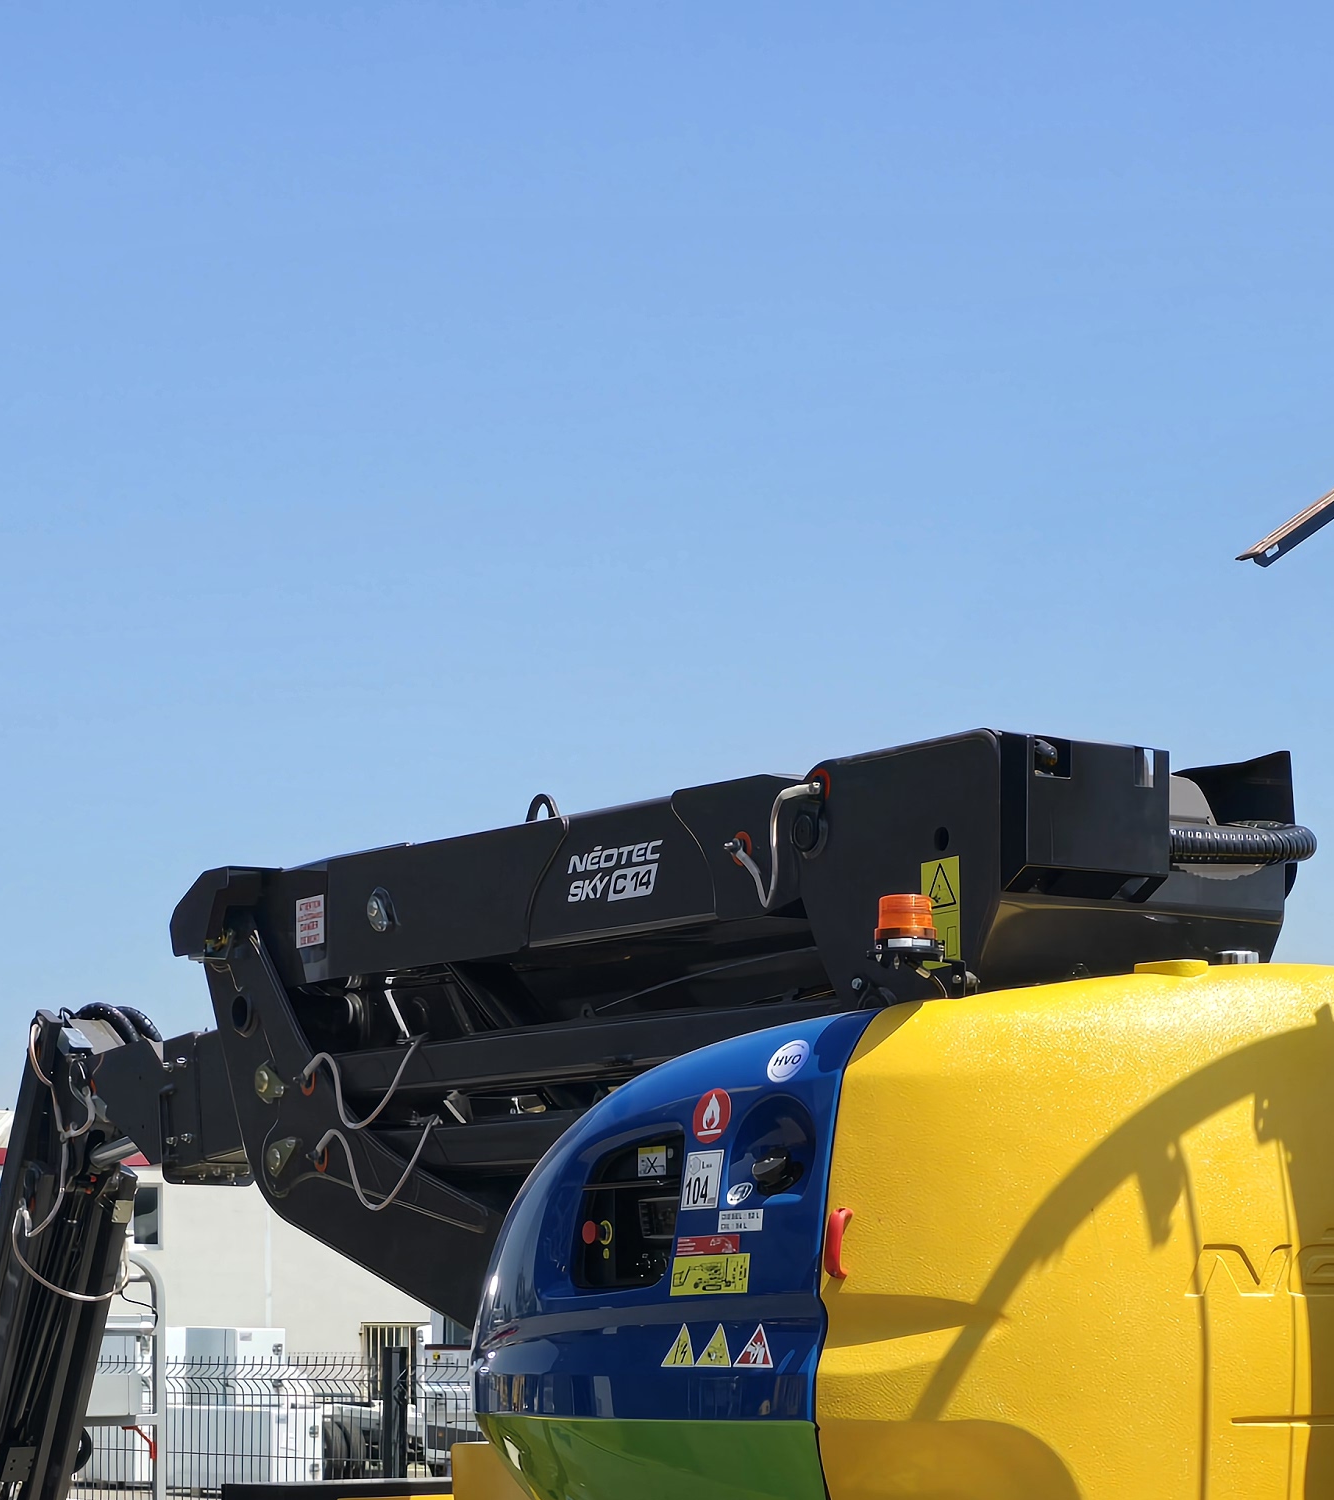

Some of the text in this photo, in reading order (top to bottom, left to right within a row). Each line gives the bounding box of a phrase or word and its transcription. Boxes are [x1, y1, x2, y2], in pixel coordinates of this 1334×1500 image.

[567, 872, 609, 902] SKY
[773, 1054, 802, 1066] HVO
[685, 1175, 709, 1205] 104
